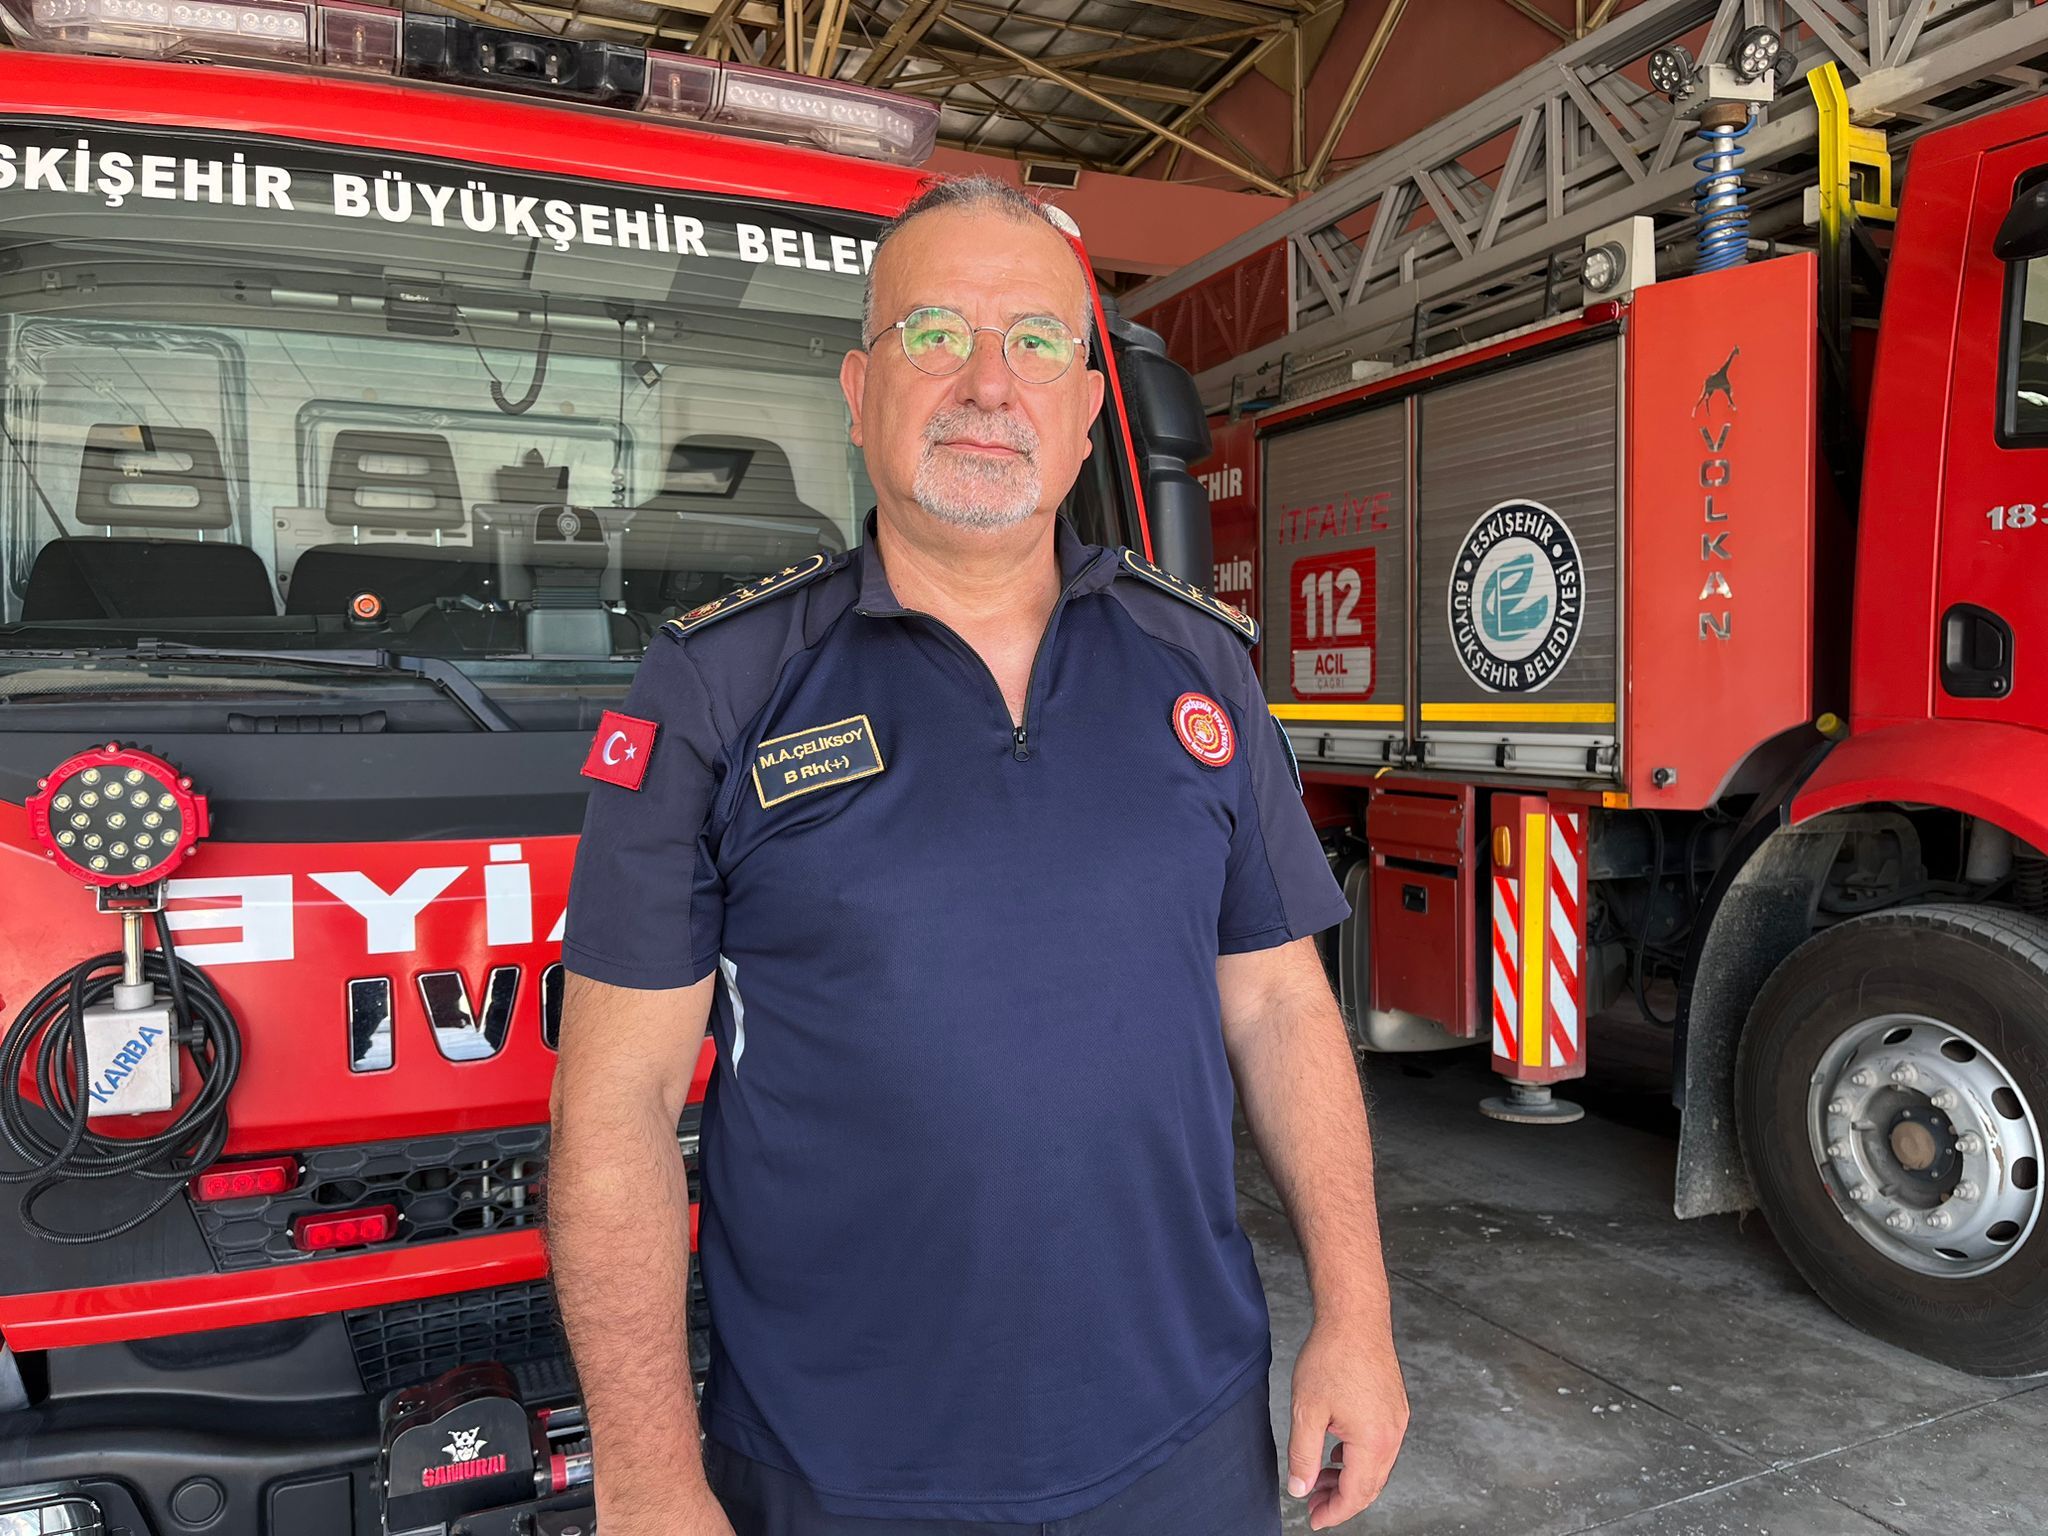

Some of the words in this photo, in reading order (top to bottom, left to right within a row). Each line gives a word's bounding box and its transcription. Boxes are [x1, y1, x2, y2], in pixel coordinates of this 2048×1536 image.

[332, 171, 709, 257] BÜYÜKŞEHİR
[1279, 491, 1392, 545] İTFAİYE
[1470, 512, 1554, 559] ESKİŞEHİR
[1699, 422, 1731, 640] VOLKAN
[1986, 503, 2048, 531] 18
[1301, 567, 1362, 640] 112
[1454, 580, 1519, 688] BÜYÜKŞEHİR
[1524, 561, 1577, 684] BELEDİYESİ
[784, 770, 798, 784] B
[800, 755, 850, 779] Rh(+)
[347, 962, 565, 1073] IV
[89, 1026, 164, 1104] KARBA
[422, 1453, 507, 1487] SAMURAI
